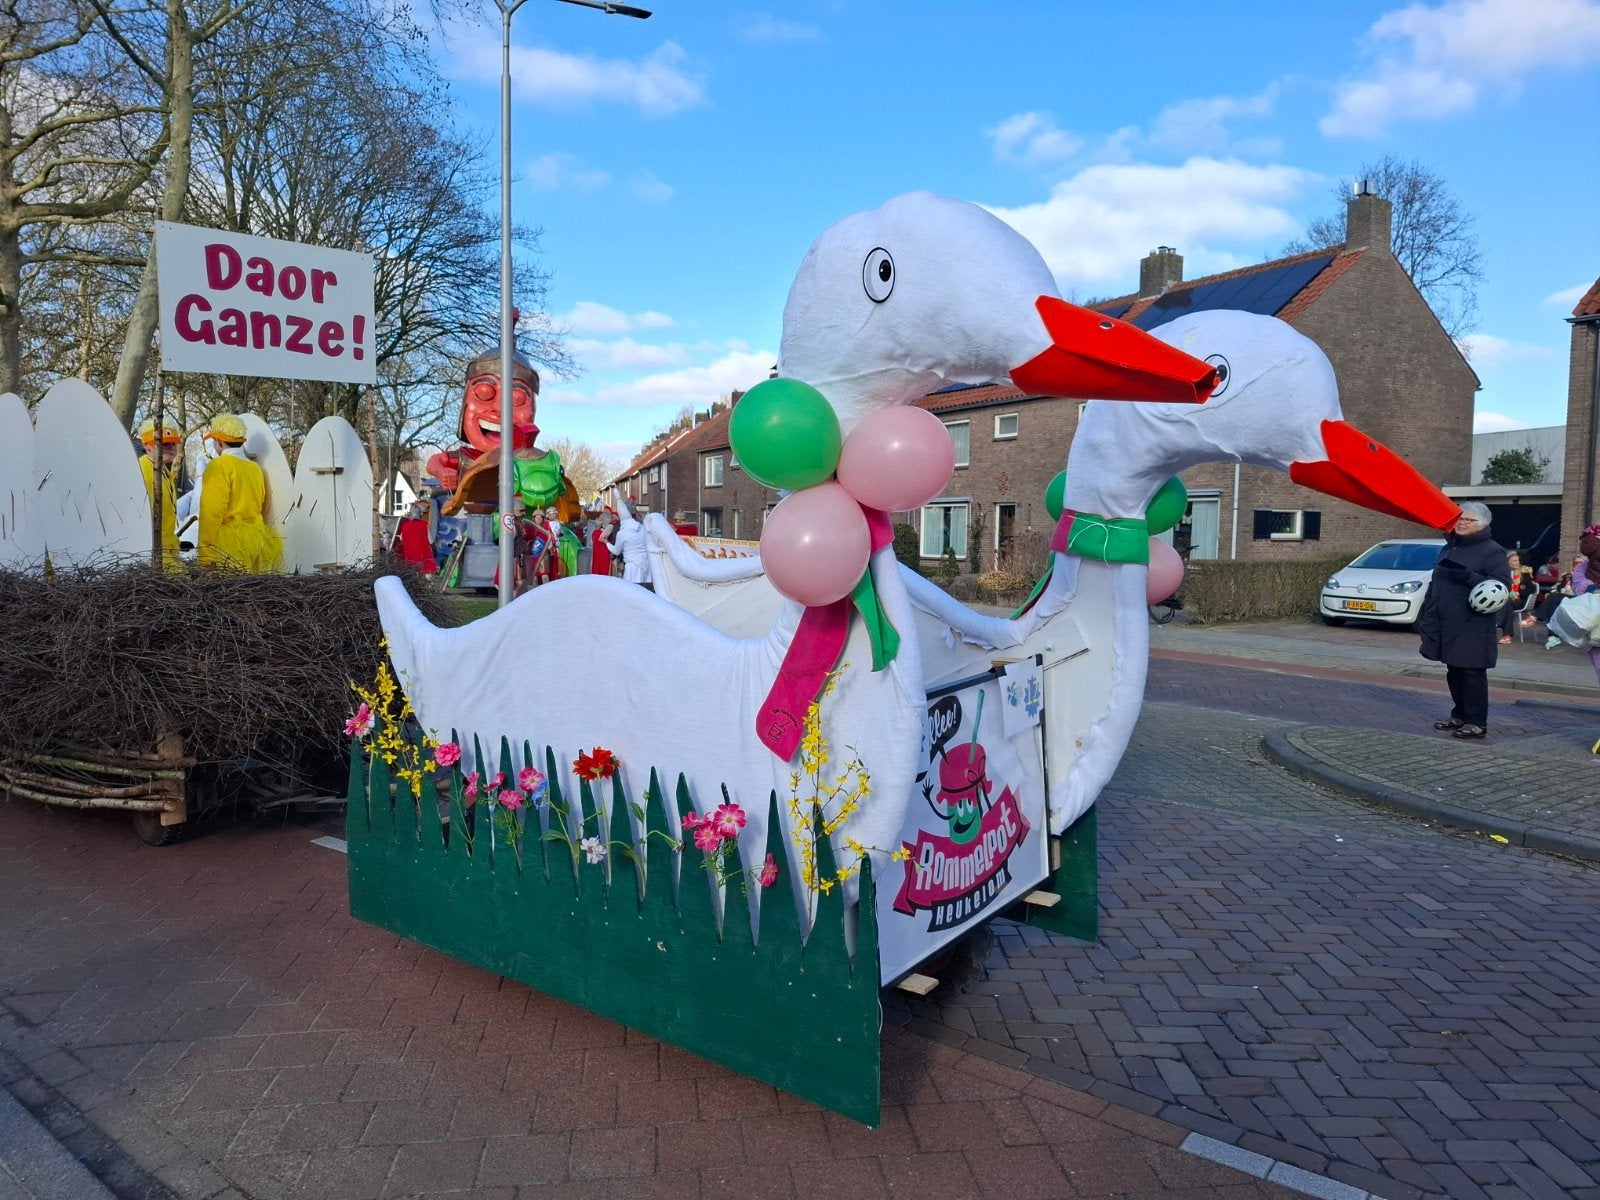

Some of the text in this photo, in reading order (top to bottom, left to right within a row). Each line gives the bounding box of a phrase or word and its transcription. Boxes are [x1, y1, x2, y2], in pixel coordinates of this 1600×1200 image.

[205, 243, 338, 304] Daor
[174, 293, 366, 361] Ganze!
[1026, 680, 1040, 706] 12
